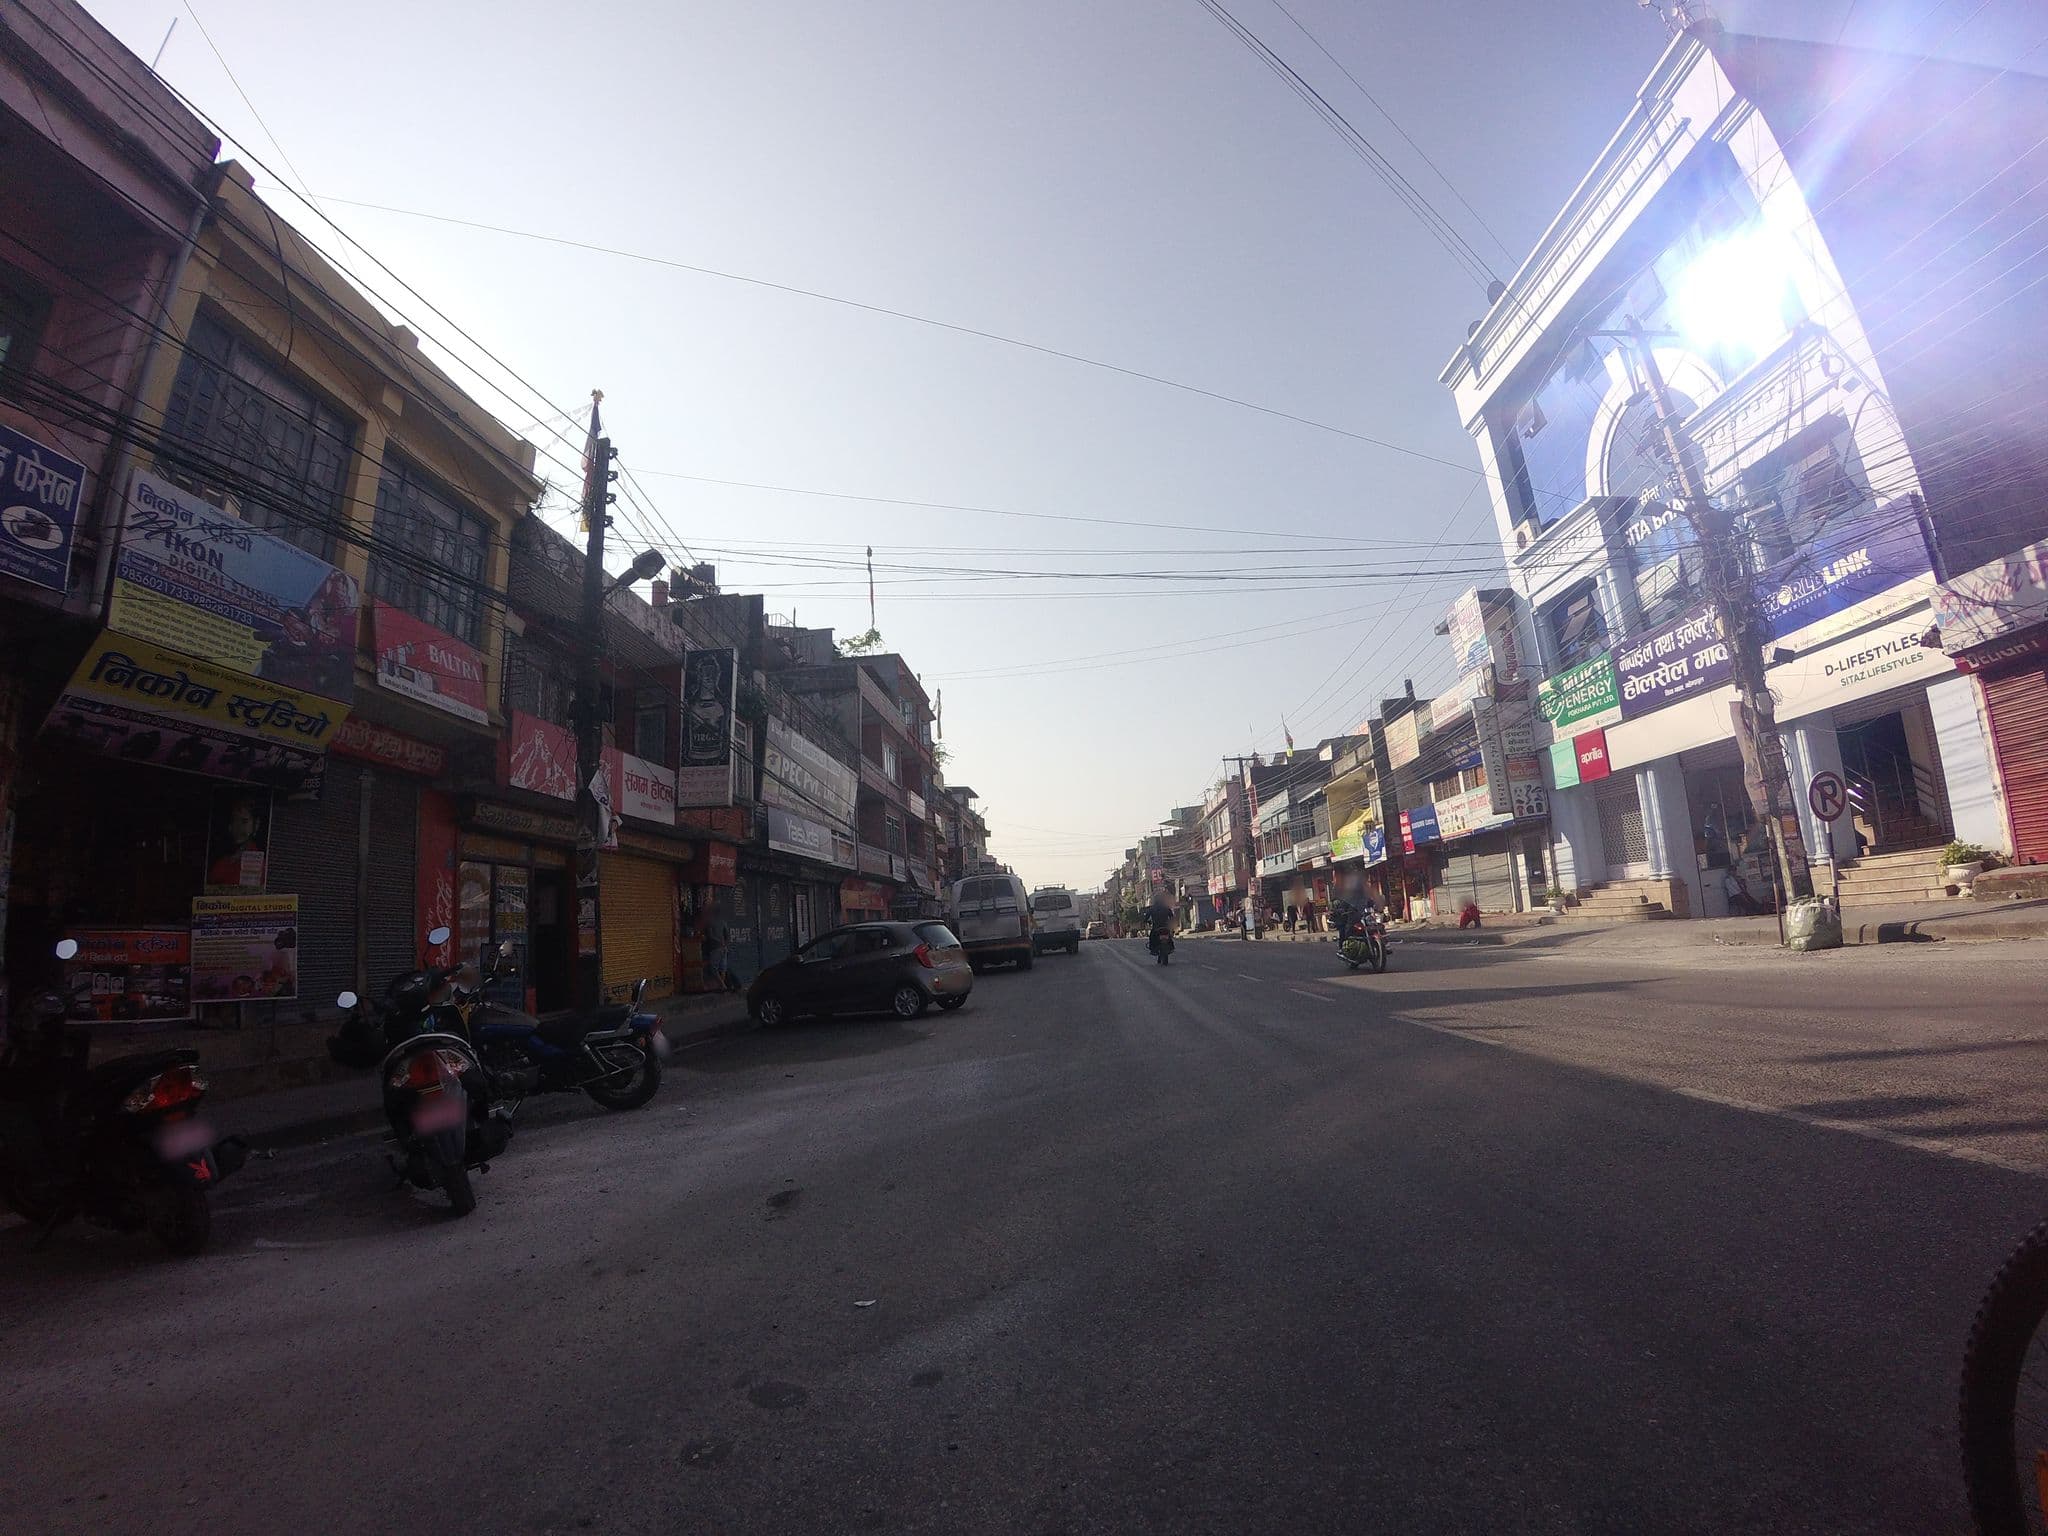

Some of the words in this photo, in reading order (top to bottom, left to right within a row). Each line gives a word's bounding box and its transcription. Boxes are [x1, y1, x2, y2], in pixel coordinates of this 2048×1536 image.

[14, 448, 77, 511] फेसन
[137, 483, 195, 526] निकोन
[1653, 632, 1675, 658] तथा
[1824, 632, 1920, 677] D-LIFESTYLES
[90, 651, 222, 708] निकोन
[1562, 659, 1609, 692] MUKTI
[1622, 660, 1689, 701] होलसेल
[1840, 671, 1866, 687] SITAZ
[1867, 651, 1925, 679] LIFESTYLES
[1566, 677, 1612, 709] ENERGY
[1581, 747, 1603, 764] aprilia
[625, 770, 649, 796] संगम
[651, 780, 674, 803] होटल
